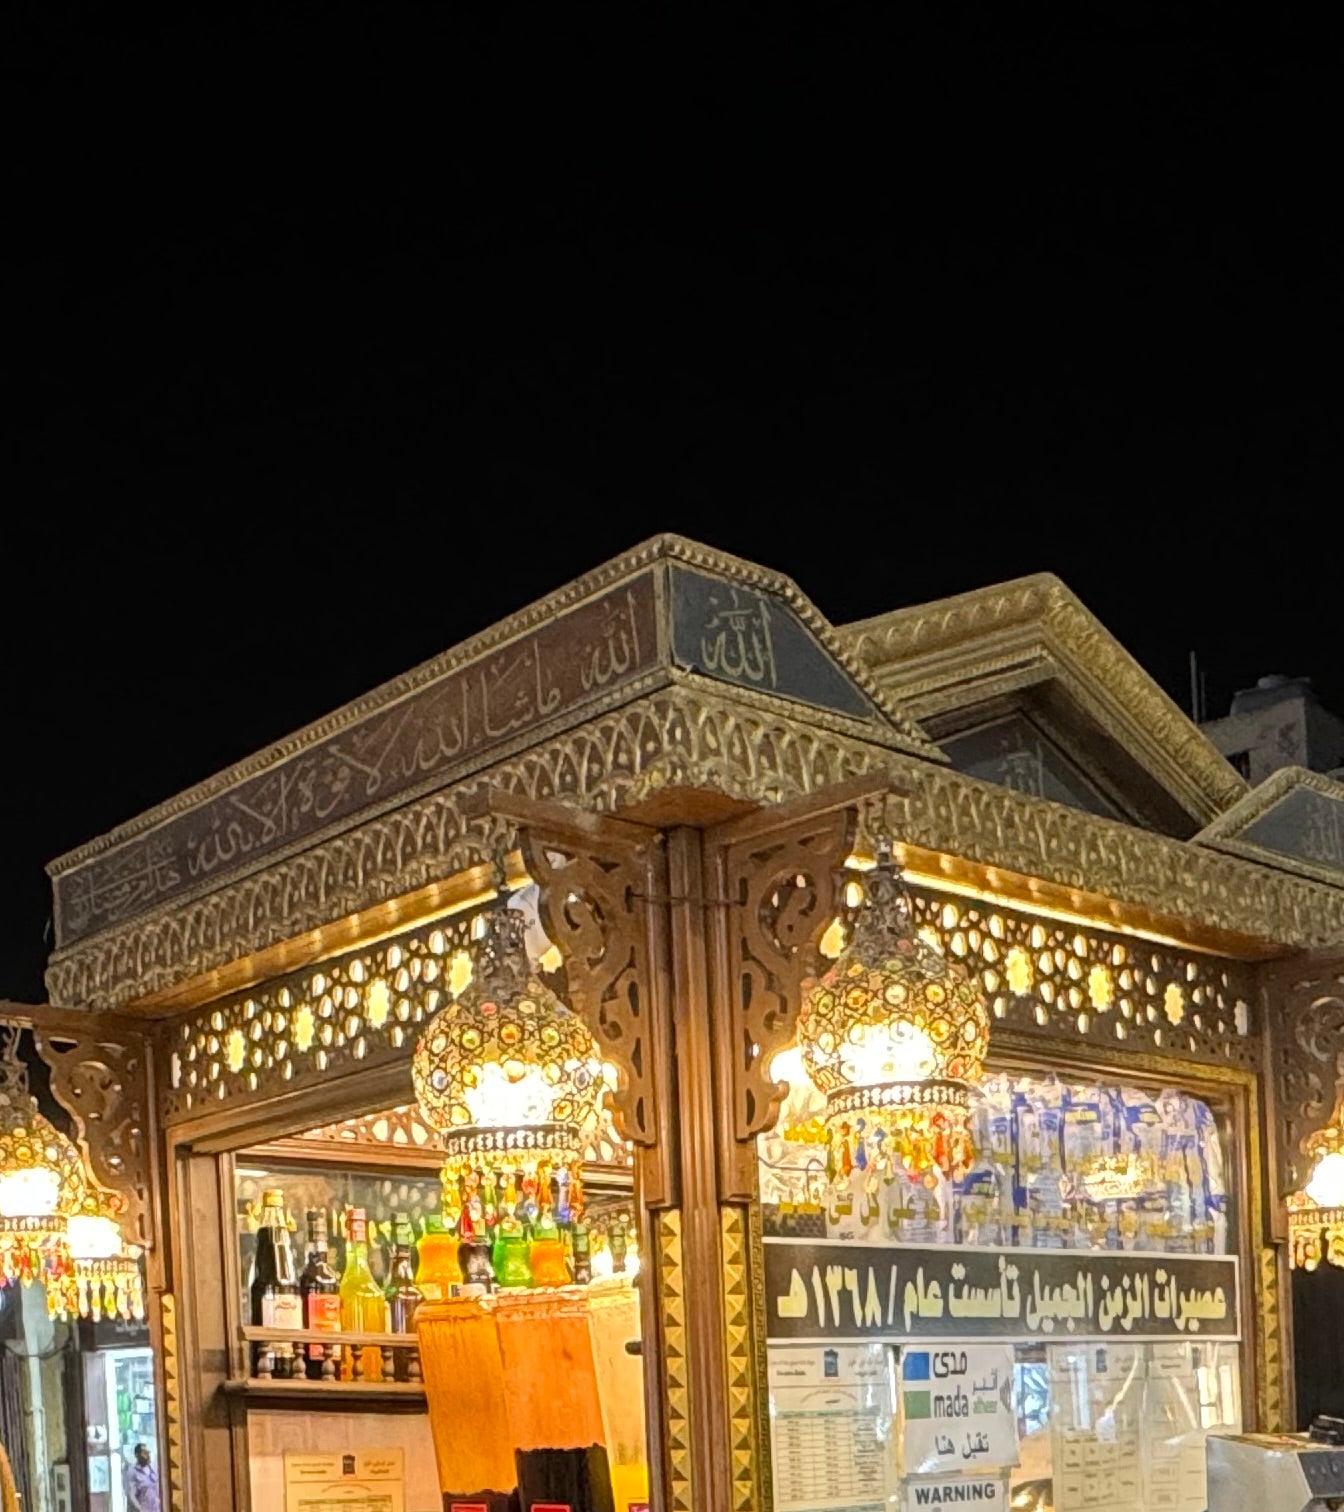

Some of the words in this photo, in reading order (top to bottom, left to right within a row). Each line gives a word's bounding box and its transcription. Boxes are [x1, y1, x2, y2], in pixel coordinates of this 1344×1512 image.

[580, 589, 640, 691] الله
[700, 588, 778, 689] الله
[903, 1266, 943, 1333] عام
[948, 1255, 1021, 1318] تأسست
[1026, 1269, 1094, 1333] الجميل
[1098, 1272, 1150, 1333] الزمن
[1154, 1267, 1226, 1333] عصيرات
[933, 1351, 968, 1378] مدى
[934, 1385, 969, 1418] mada
[934, 1435, 955, 1455] هنا
[962, 1432, 989, 1459] تقبل
[915, 1482, 996, 1505] WARNING
